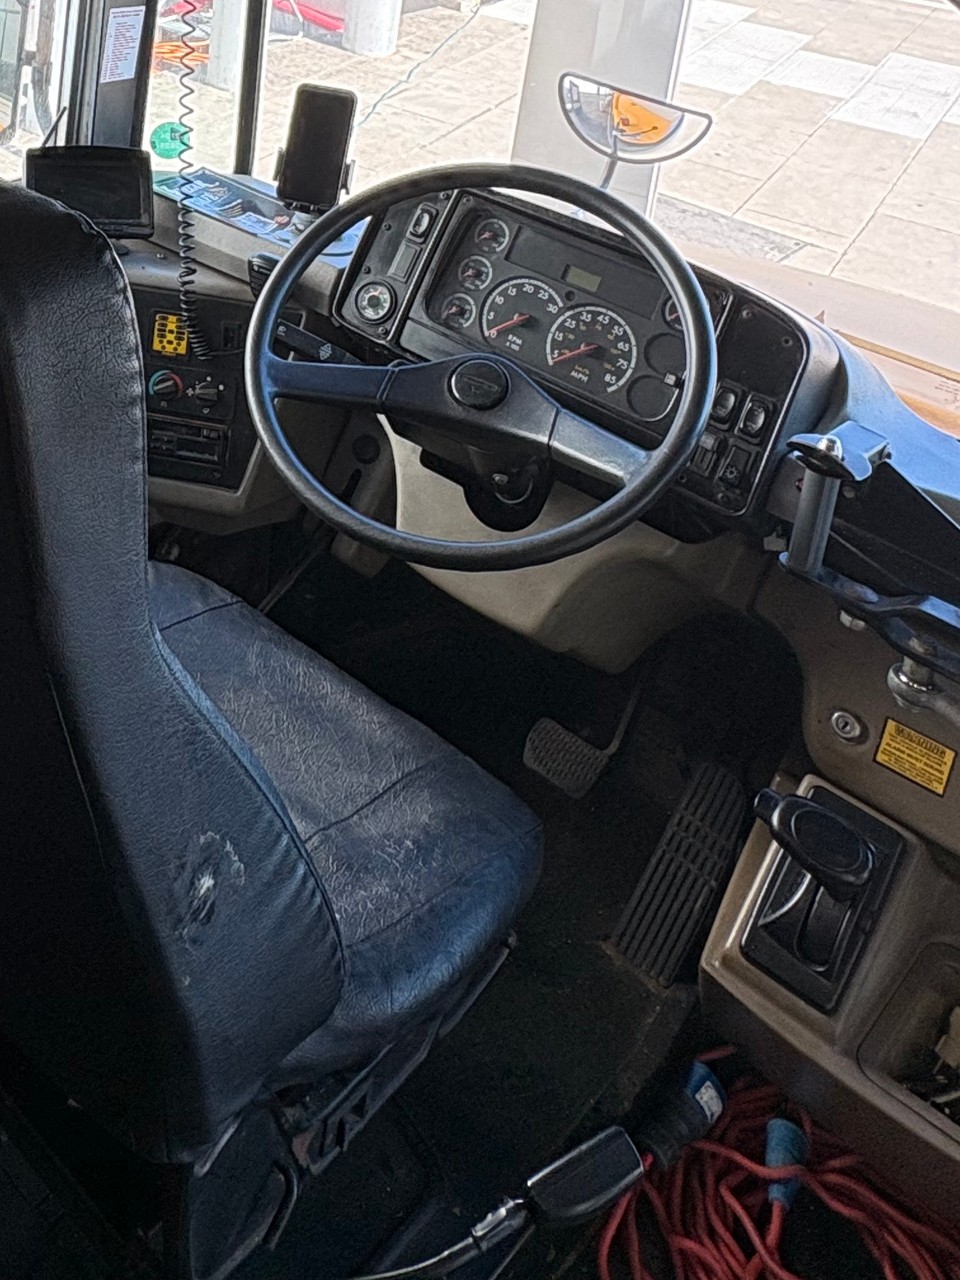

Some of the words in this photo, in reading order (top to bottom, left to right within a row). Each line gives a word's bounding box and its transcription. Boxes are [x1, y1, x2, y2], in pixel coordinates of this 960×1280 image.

[508, 286, 517, 296] 15
[522, 284, 534, 293] 20
[537, 289, 549, 300] 25
[495, 295, 504, 305] 10
[546, 302, 559, 314] 30
[488, 311, 495, 320] 5
[580, 312, 592, 322] 35
[597, 315, 610, 324] 45
[565, 318, 576, 328] 25
[612, 325, 624, 336] 55
[554, 331, 563, 341] 15
[617, 341, 630, 351] 65
[552, 349, 559, 358] 5
[616, 358, 628, 370] 75
[570, 370, 589, 383] MPH
[604, 373, 616, 384] 85
